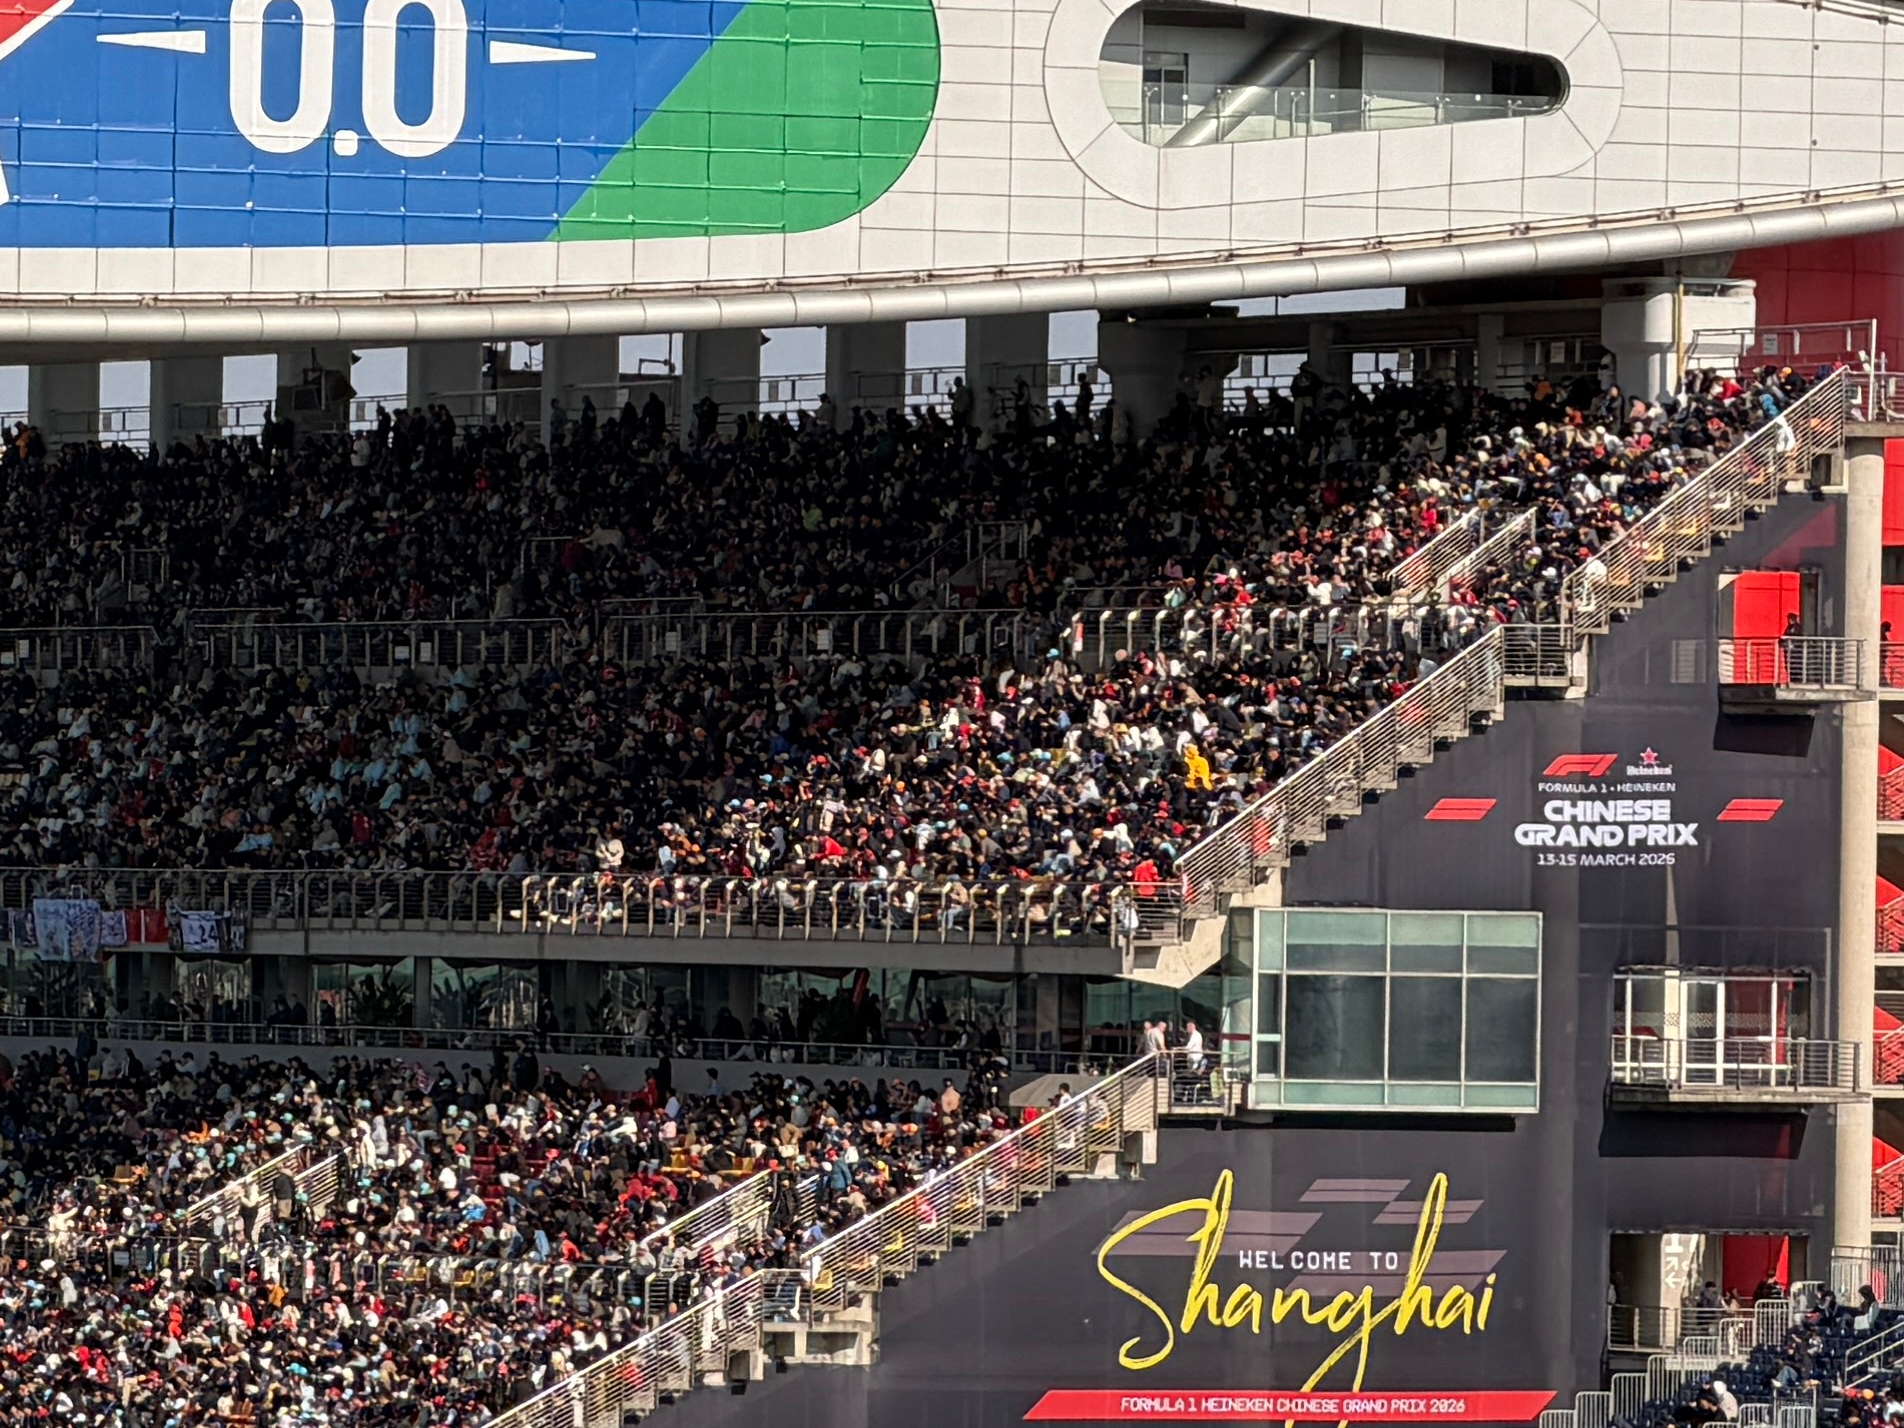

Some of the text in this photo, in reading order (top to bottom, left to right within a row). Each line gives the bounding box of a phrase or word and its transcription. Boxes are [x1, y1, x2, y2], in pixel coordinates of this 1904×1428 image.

[1538, 782, 1676, 793] FORMULA 1 HEINEKEN
[1543, 799, 1671, 822] CHINESE
[1514, 823, 1699, 847] GRAND PRIX
[1537, 853, 1676, 866] 13-15 MARCH 2026
[1238, 1249, 1400, 1271] WELCOME TO
[1121, 1396, 1466, 1413] FORMULA 1 HEINEKEN CHINESE GRAND PRIX 2026
